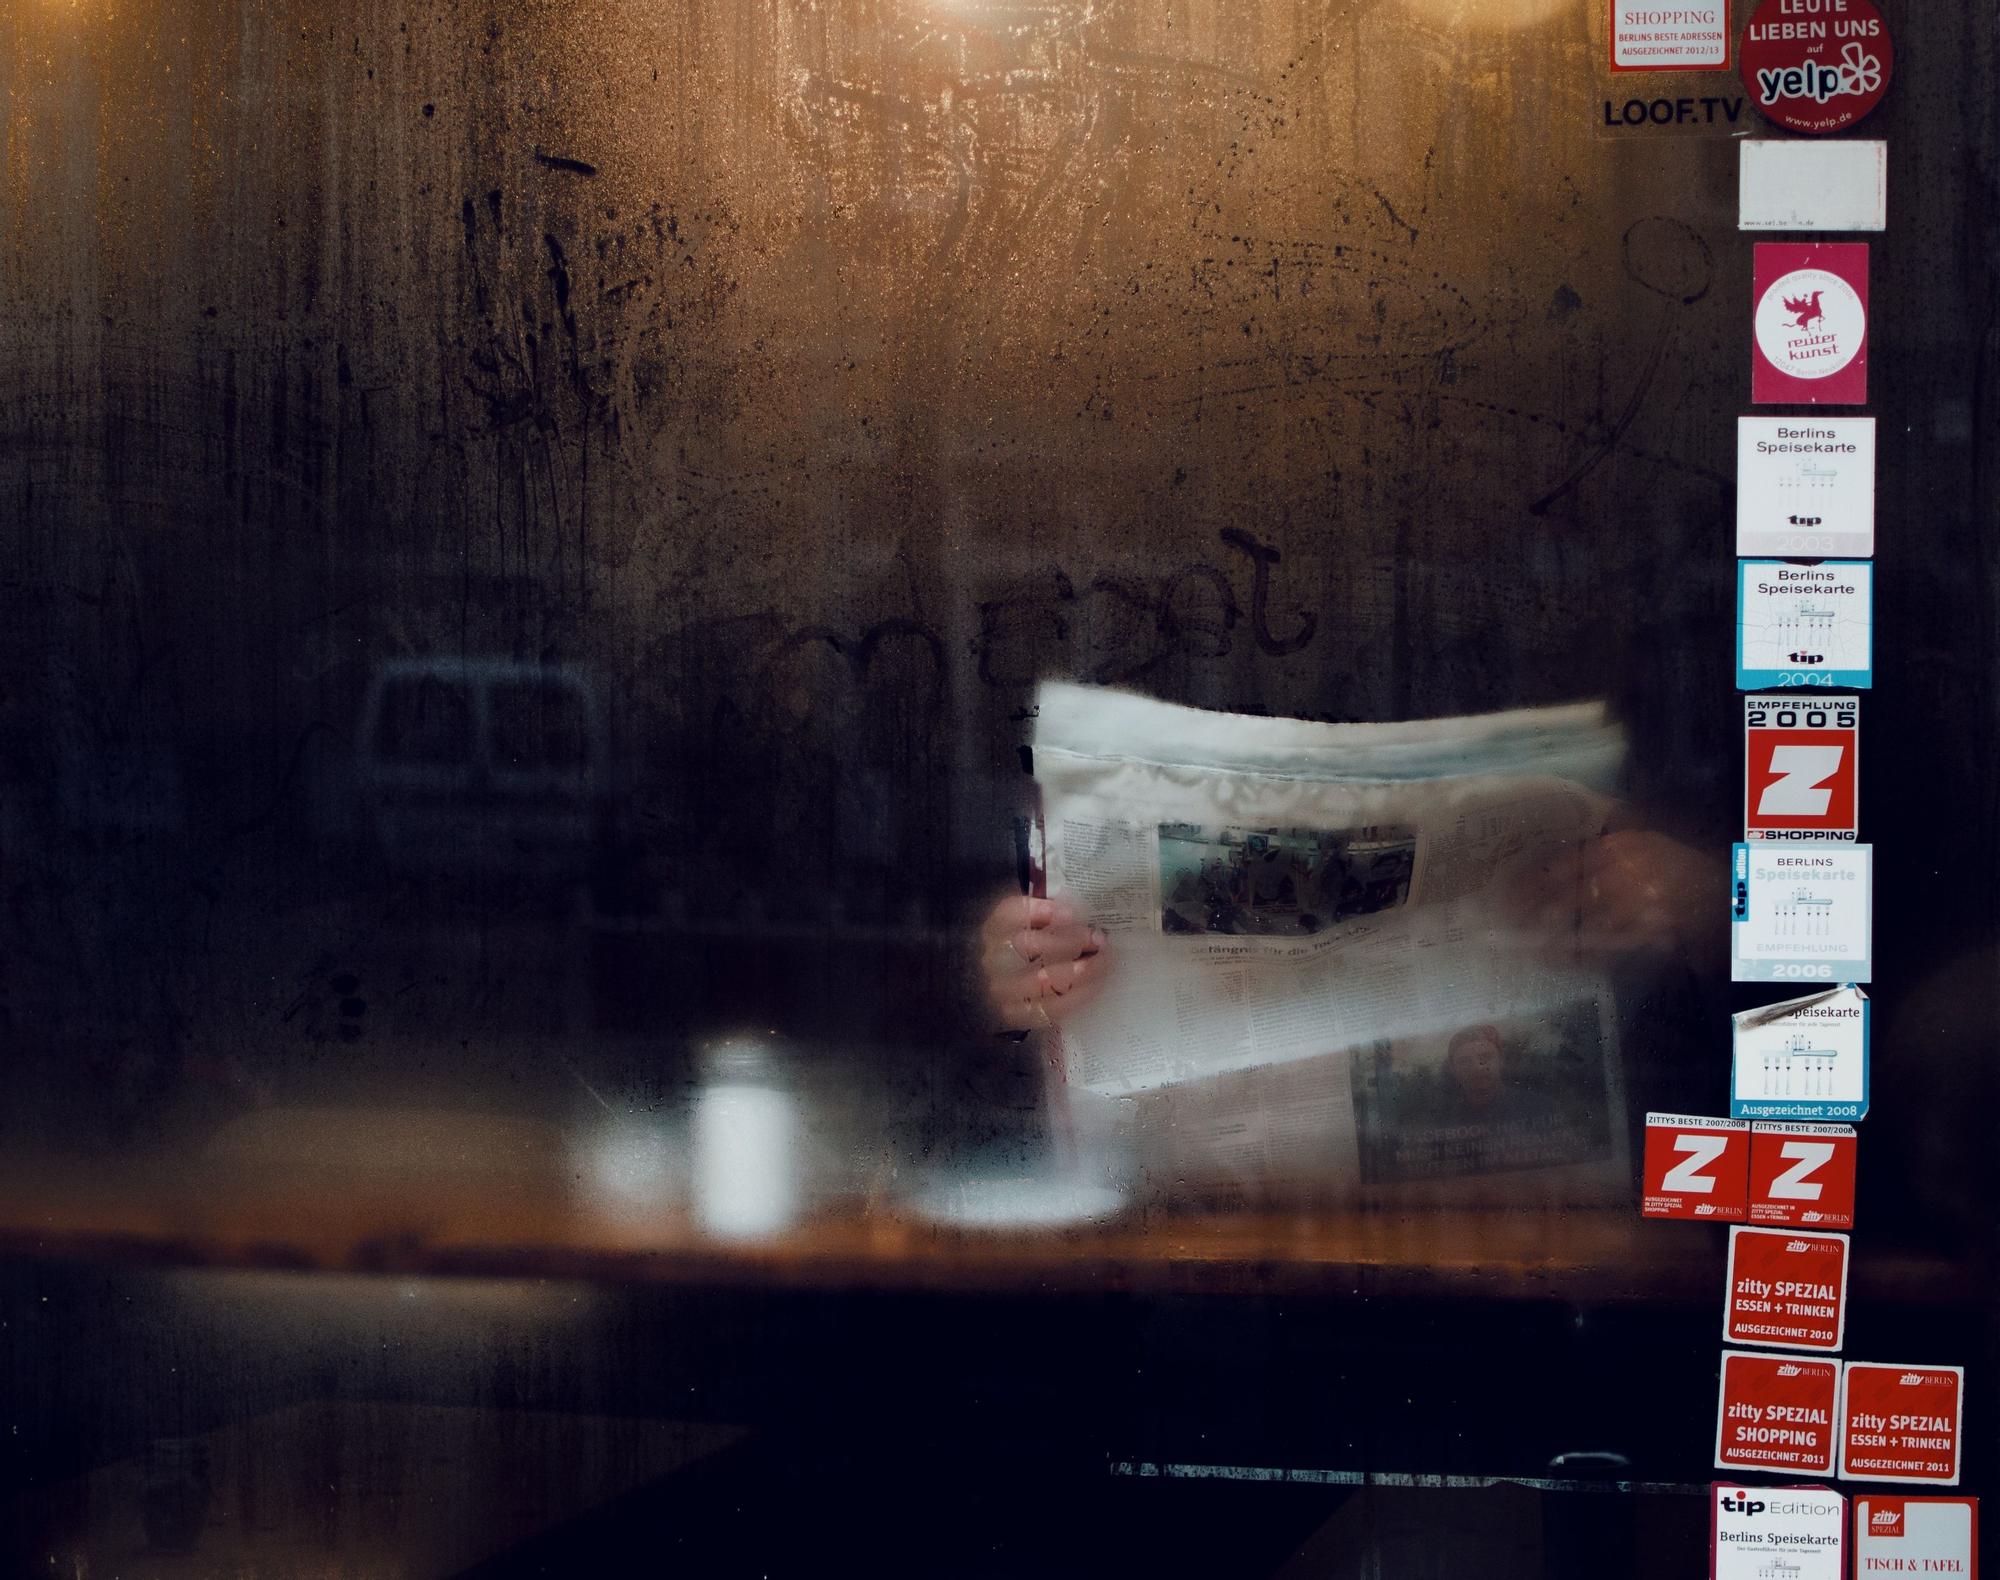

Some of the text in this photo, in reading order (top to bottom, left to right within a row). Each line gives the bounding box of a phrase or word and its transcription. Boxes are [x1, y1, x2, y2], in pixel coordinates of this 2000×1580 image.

[1780, 0, 1848, 14] LEUTE
[1624, 10, 1715, 25] SHOPPING
[1618, 31, 1723, 42] BERLINS BESTE ADRESSEN
[1750, 19, 1880, 41] LIEBEN UNS
[1622, 46, 1719, 56] AUSGEZEICHNET 2012/13
[1806, 43, 1824, 53] auf
[1759, 61, 1840, 102] yelp
[1604, 98, 1744, 126] LOOF.TV
[1785, 112, 1852, 130] www.yelp.de
[1787, 333, 1838, 349] reuter
[1789, 343, 1840, 361] kunst
[1777, 427, 1836, 439] Berlins
[1756, 441, 1857, 455] Speisekarte
[1778, 570, 1835, 581] Berlins
[1757, 583, 1856, 596] Speisekarte
[1787, 651, 1824, 665] tip
[1777, 672, 1834, 687] 2004
[1747, 701, 1856, 710] EMPFEHLUNG
[1748, 710, 1856, 728] 2005
[1757, 745, 1845, 816] Z
[1765, 830, 1855, 841] SHOPPING
[1777, 858, 1834, 866] BERLINS
[1755, 868, 1856, 882] Speisekarte
[1731, 848, 1747, 918] tip edition
[1756, 943, 1849, 953] EMPFEHLUNG
[1772, 964, 1833, 977] 2006
[1741, 1104, 1857, 1116] Ausgezeichnet 2008
[1648, 1116, 1746, 1128] ZITTYS BESTE 2007/2008
[1754, 1122, 1854, 1134] ZITTYS BESTE 2007/2008
[1694, 1203, 1743, 1215] zitty BERLIN
[1801, 1210, 1850, 1222] zitty BERLIN
[1785, 1240, 1840, 1253] zitty BERLIN
[1737, 1278, 1837, 1300] zitty SPEZIAL
[1735, 1299, 1835, 1318] ESSEN + TRINKEN
[1735, 1323, 1833, 1340] AUSGEZEICHNET 2010
[1776, 1363, 1831, 1377] zitty BERLIN
[1899, 1372, 1954, 1386] zitty BERLIN
[1728, 1402, 1828, 1425] zitty SPEZIAL
[1851, 1412, 1953, 1433] zitty SPEZIAL
[1735, 1426, 1817, 1447] SHOPPING
[1850, 1434, 1951, 1450] ESSEN + TRINKEN
[1726, 1447, 1825, 1464] AUSGEZEICHNET 2011
[1850, 1458, 1950, 1472] AUSGEZEICHNET 2011
[1720, 1490, 1840, 1517] tip Edition
[1871, 1510, 1901, 1525] zitty
[1871, 1525, 1901, 1534] SPEZIAL
[1719, 1531, 1839, 1547] Berlins Speisekarte
[1865, 1557, 1964, 1573] TISCH & TAFEL
